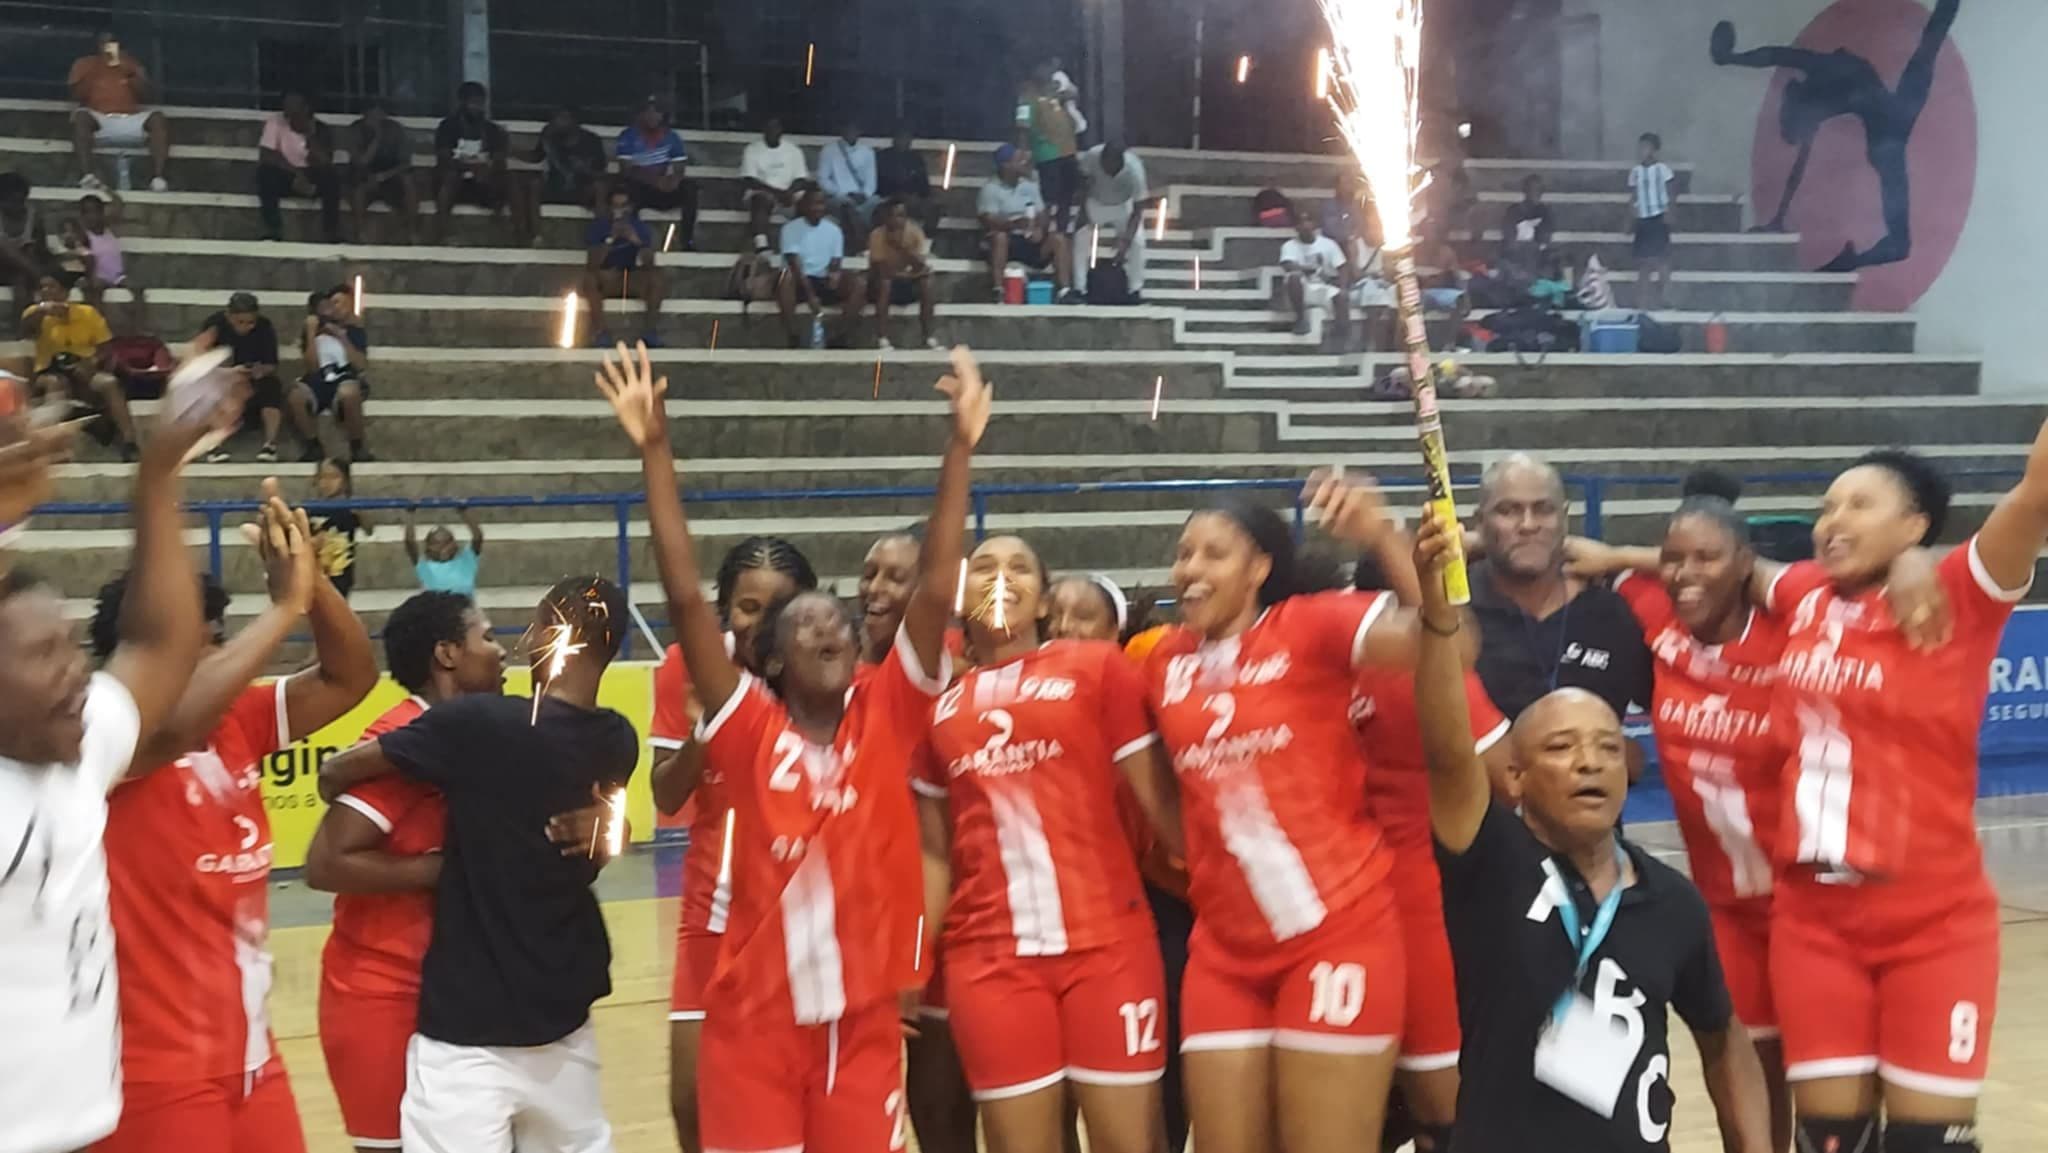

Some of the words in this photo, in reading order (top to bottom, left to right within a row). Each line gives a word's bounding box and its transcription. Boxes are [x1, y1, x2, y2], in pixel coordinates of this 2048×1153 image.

[769, 730, 804, 792] 2
[1308, 961, 1366, 1026] 10
[1119, 998, 1160, 1056] 12
